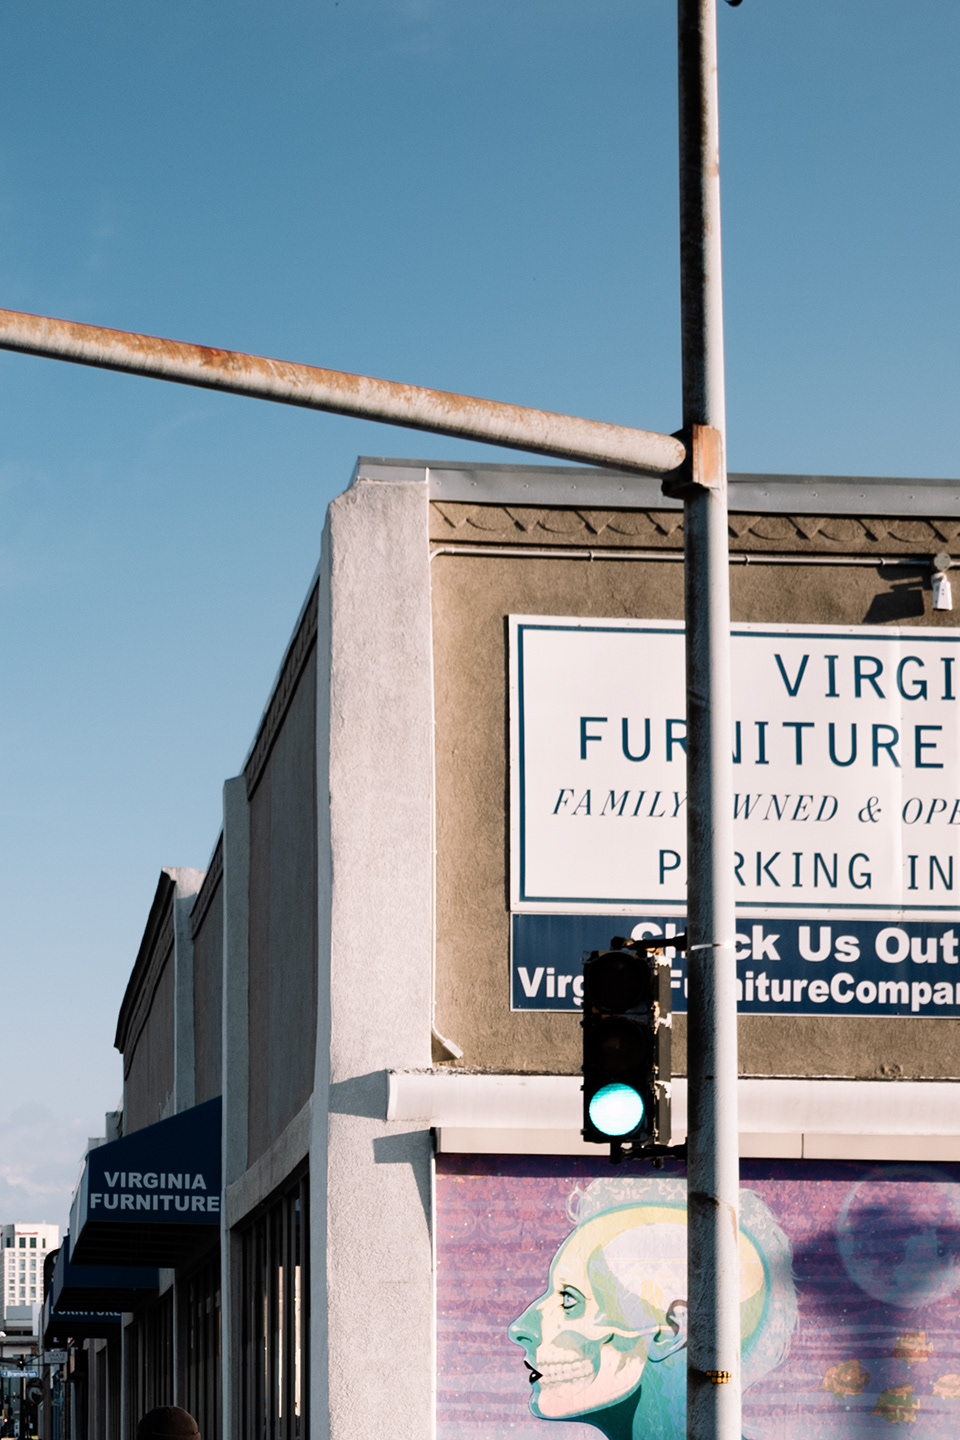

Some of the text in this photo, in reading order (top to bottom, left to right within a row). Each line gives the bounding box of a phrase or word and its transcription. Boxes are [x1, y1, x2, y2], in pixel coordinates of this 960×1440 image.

[774, 653, 957, 701] VIRGI
[552, 788, 688, 818] FAMILY
[732, 793, 839, 823] WNED
[857, 796, 882, 824] &
[658, 849, 954, 891] PRKING IN
[630, 922, 959, 964] Chck Us Out
[103, 1171, 207, 1190] VIRGINIA
[90, 1193, 220, 1212] FURNITURE
